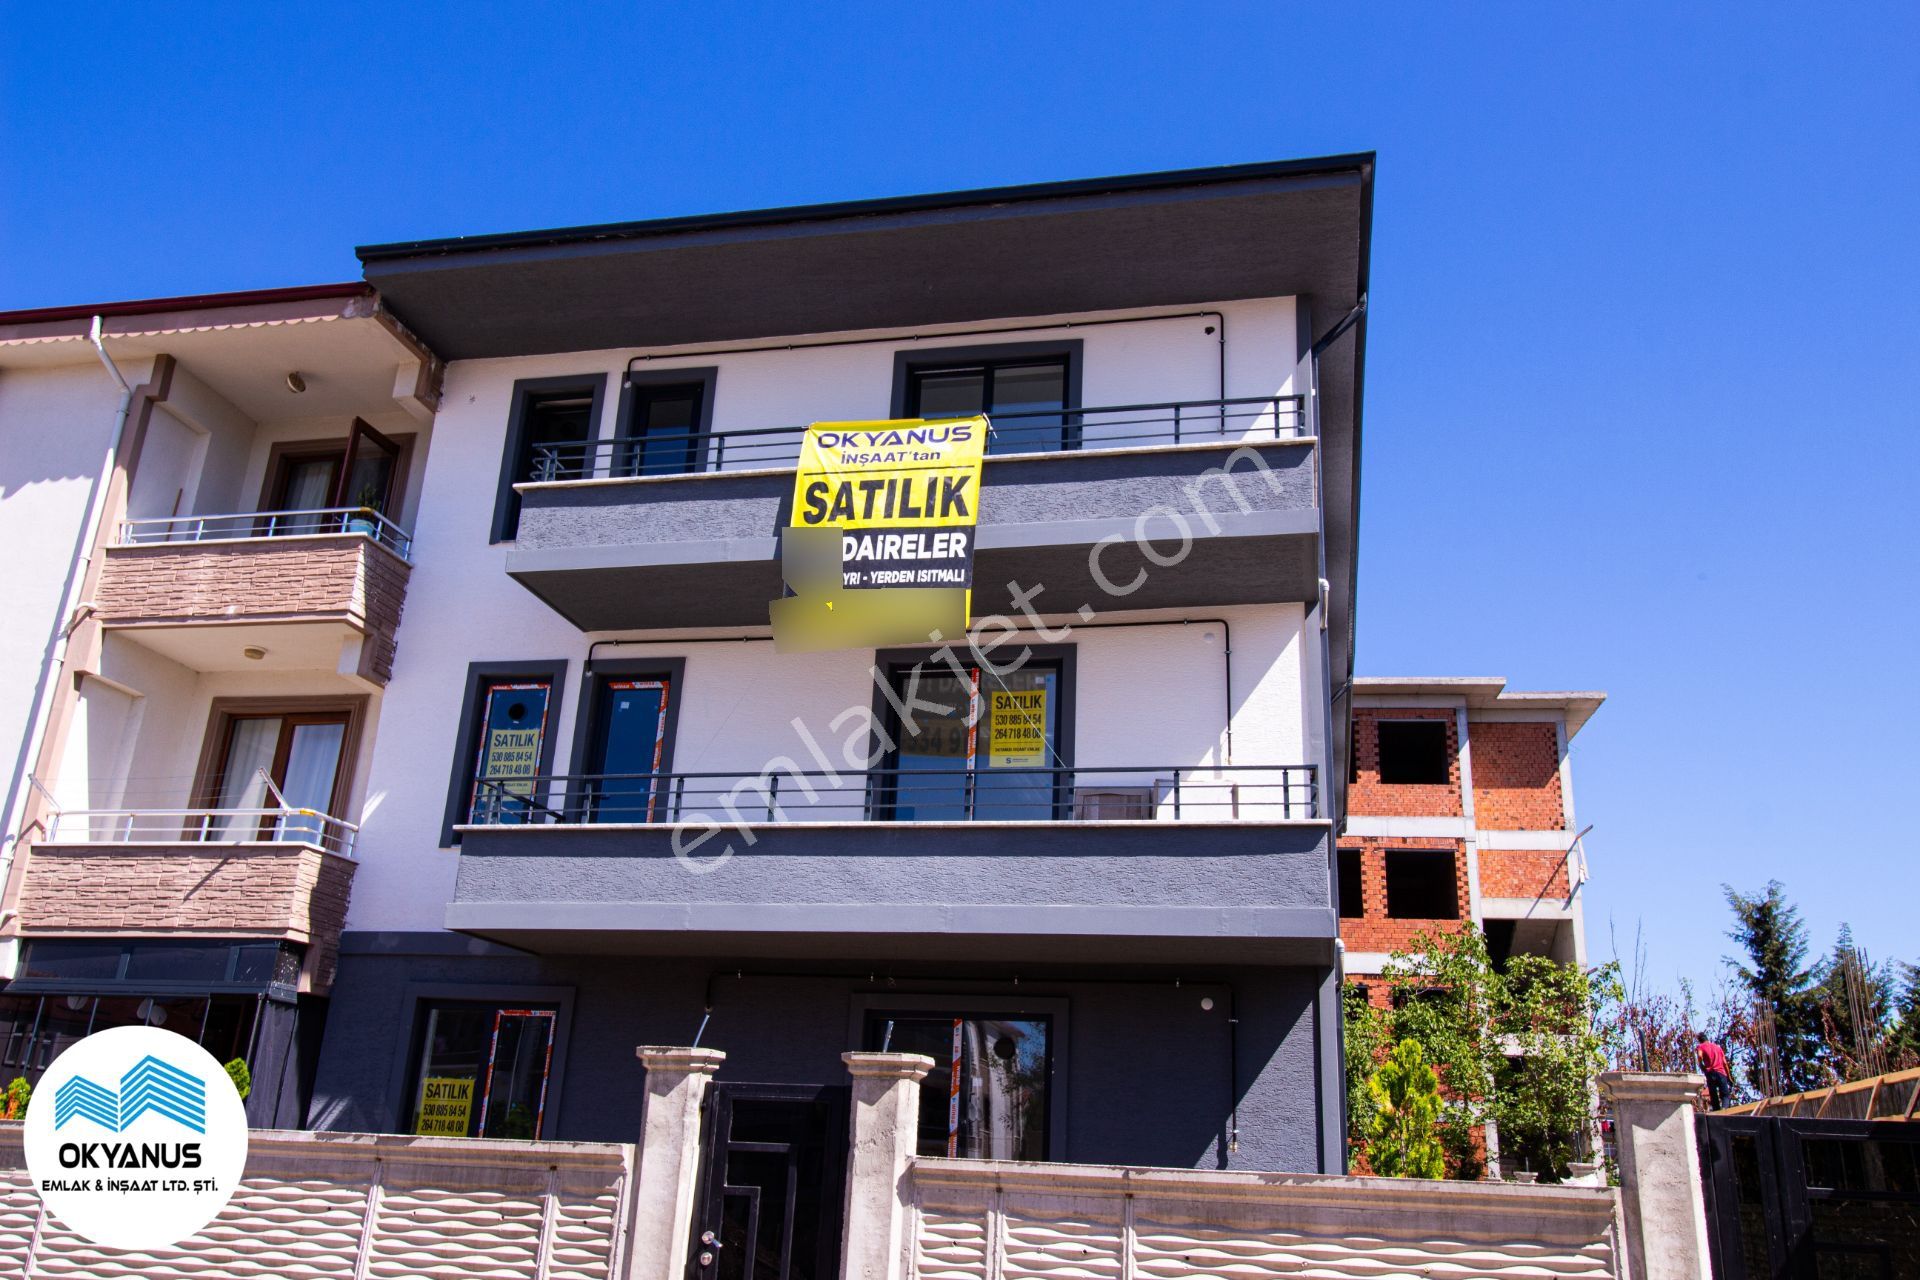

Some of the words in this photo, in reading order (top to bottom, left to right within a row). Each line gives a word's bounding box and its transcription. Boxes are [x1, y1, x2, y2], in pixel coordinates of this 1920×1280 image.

[817, 425, 972, 449] OKYANUS
[802, 475, 972, 525] SATILIK
[870, 570, 915, 584] YERDEN
[917, 569, 965, 583] ISITMALI
[995, 695, 1042, 710] SATILIK
[995, 714, 1008, 725] 530
[1009, 714, 1021, 725] 885
[1033, 713, 1042, 725] 54
[494, 734, 535, 747] SATILIK
[995, 728, 1007, 740] 264
[1008, 728, 1021, 739] 718
[524, 752, 532, 762] 54
[426, 1083, 470, 1099] SATILIK
[457, 1105, 466, 1117] 54
